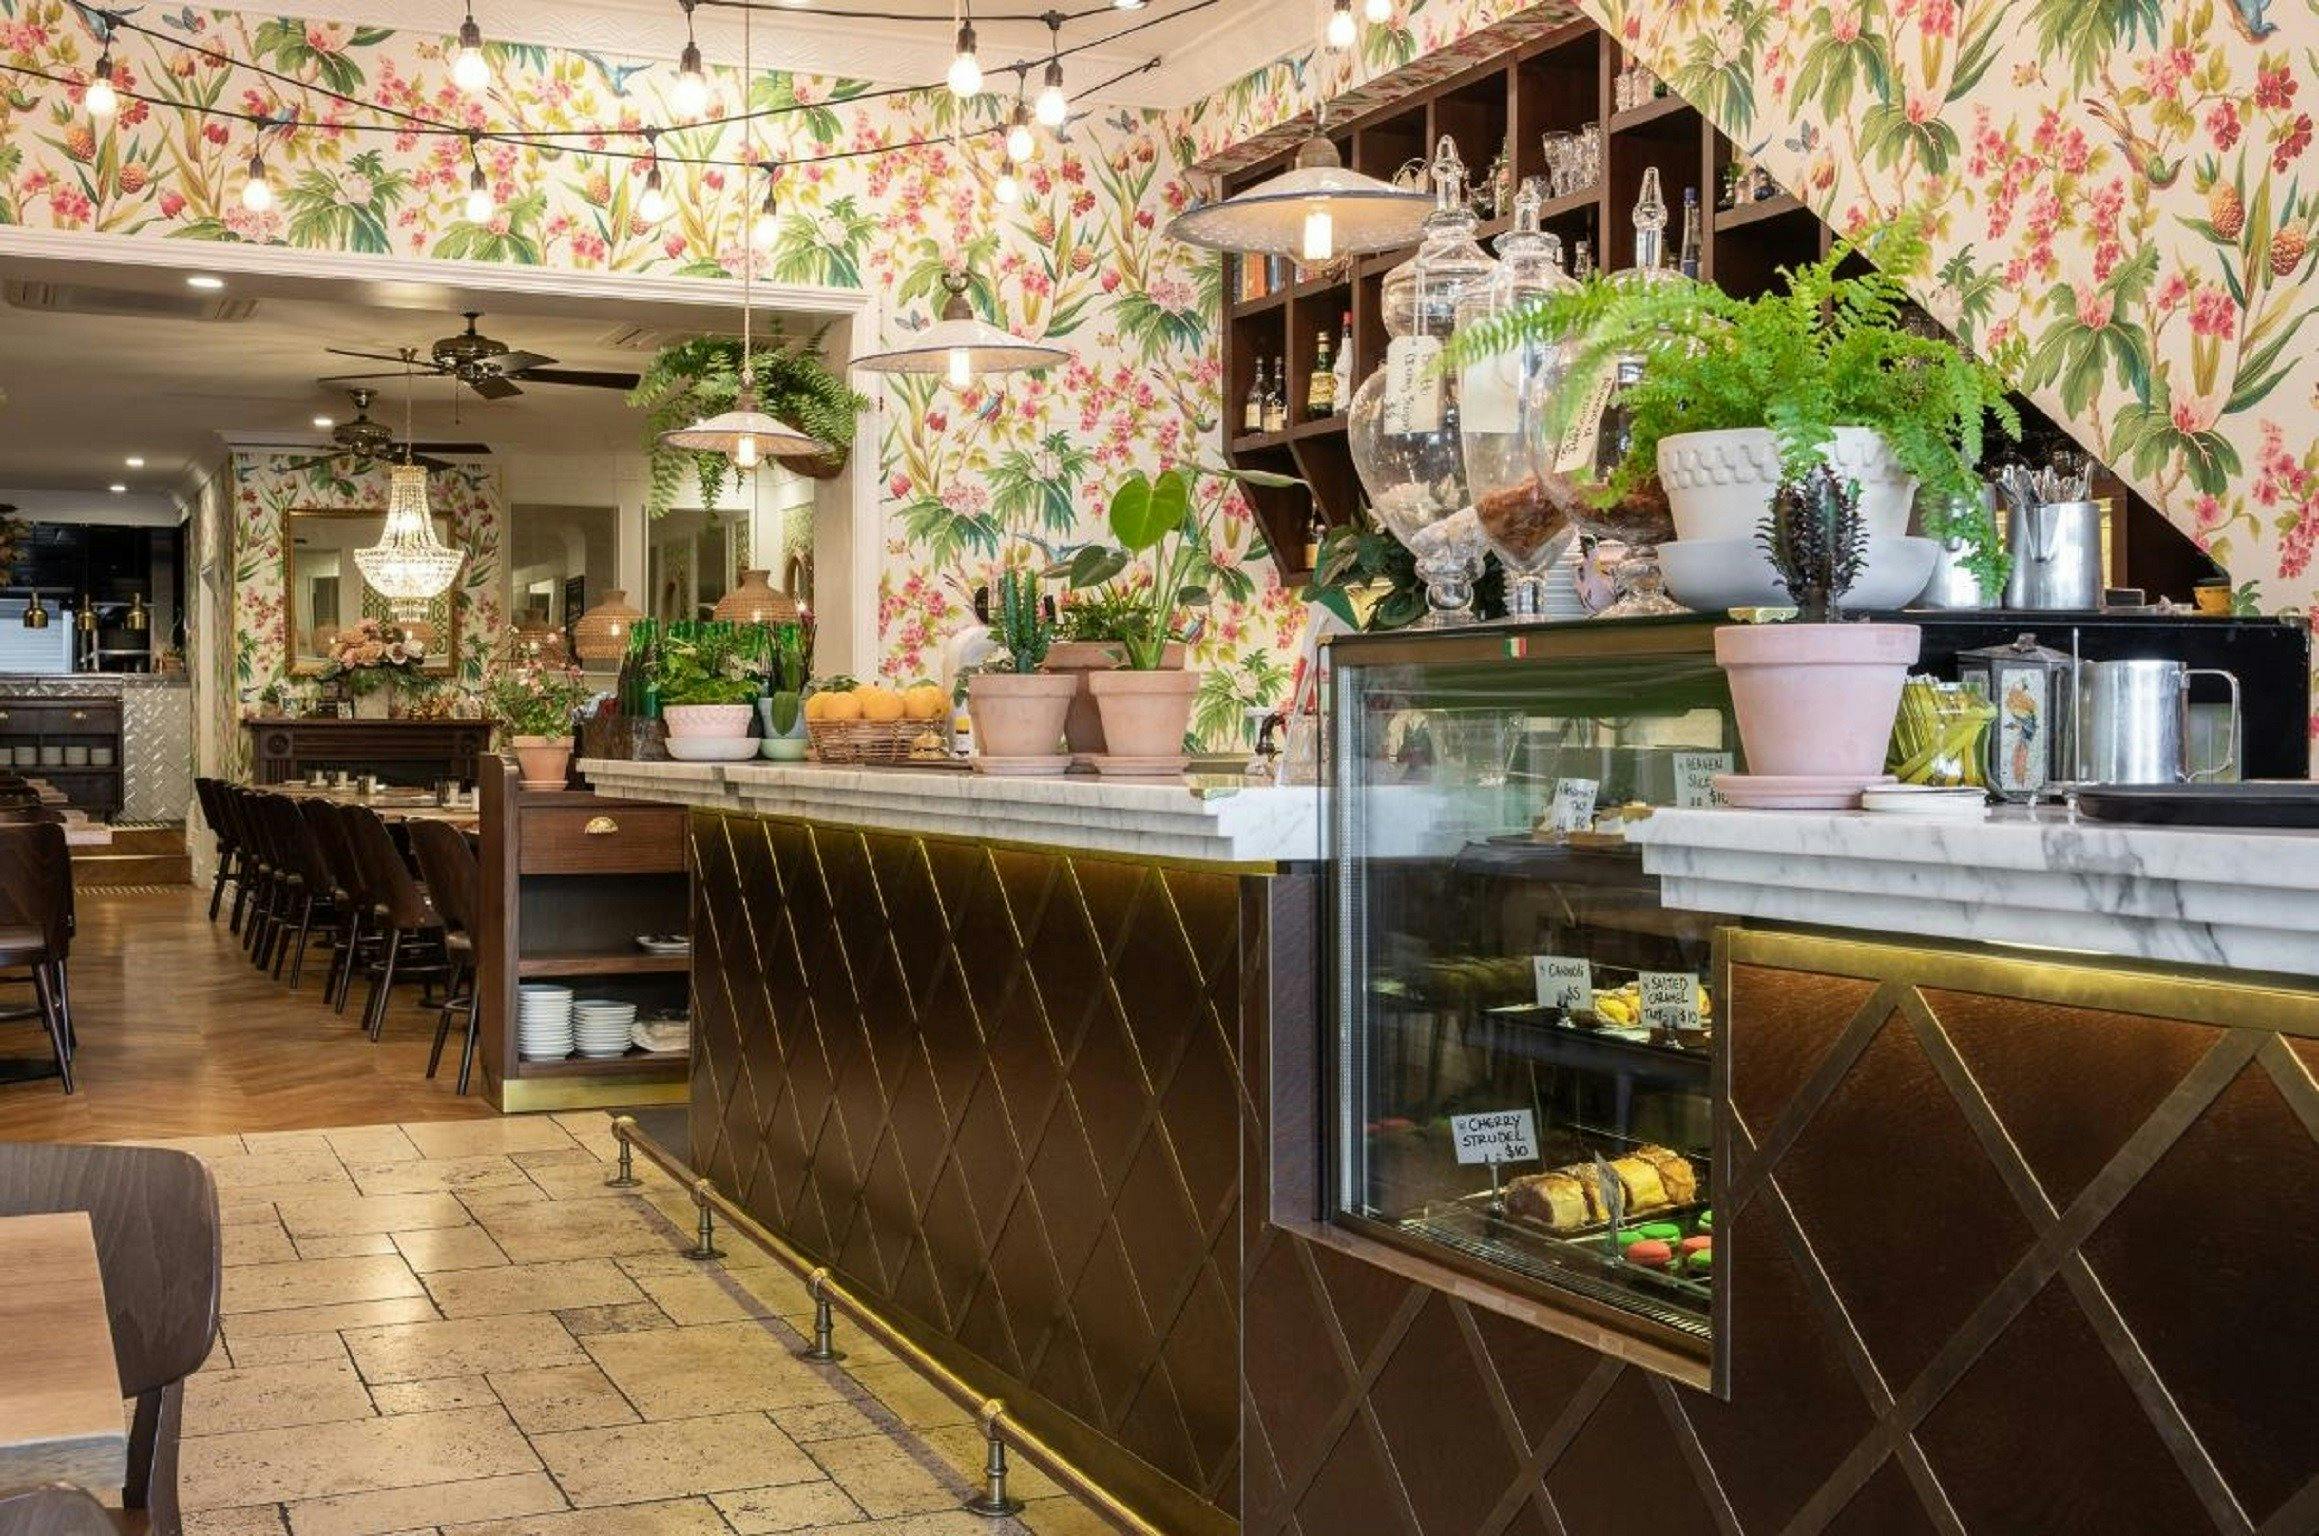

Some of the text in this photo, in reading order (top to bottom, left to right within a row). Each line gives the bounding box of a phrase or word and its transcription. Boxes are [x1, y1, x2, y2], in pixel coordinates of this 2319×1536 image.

[1651, 975, 1689, 991] SALTED
[1648, 990, 1689, 1004] CARAMEL
[1680, 1009, 1698, 1024] $10
[1468, 1115, 1521, 1132] CHERRY
[1462, 1130, 1525, 1147] STRUDEL
[1504, 1142, 1529, 1159] $10
